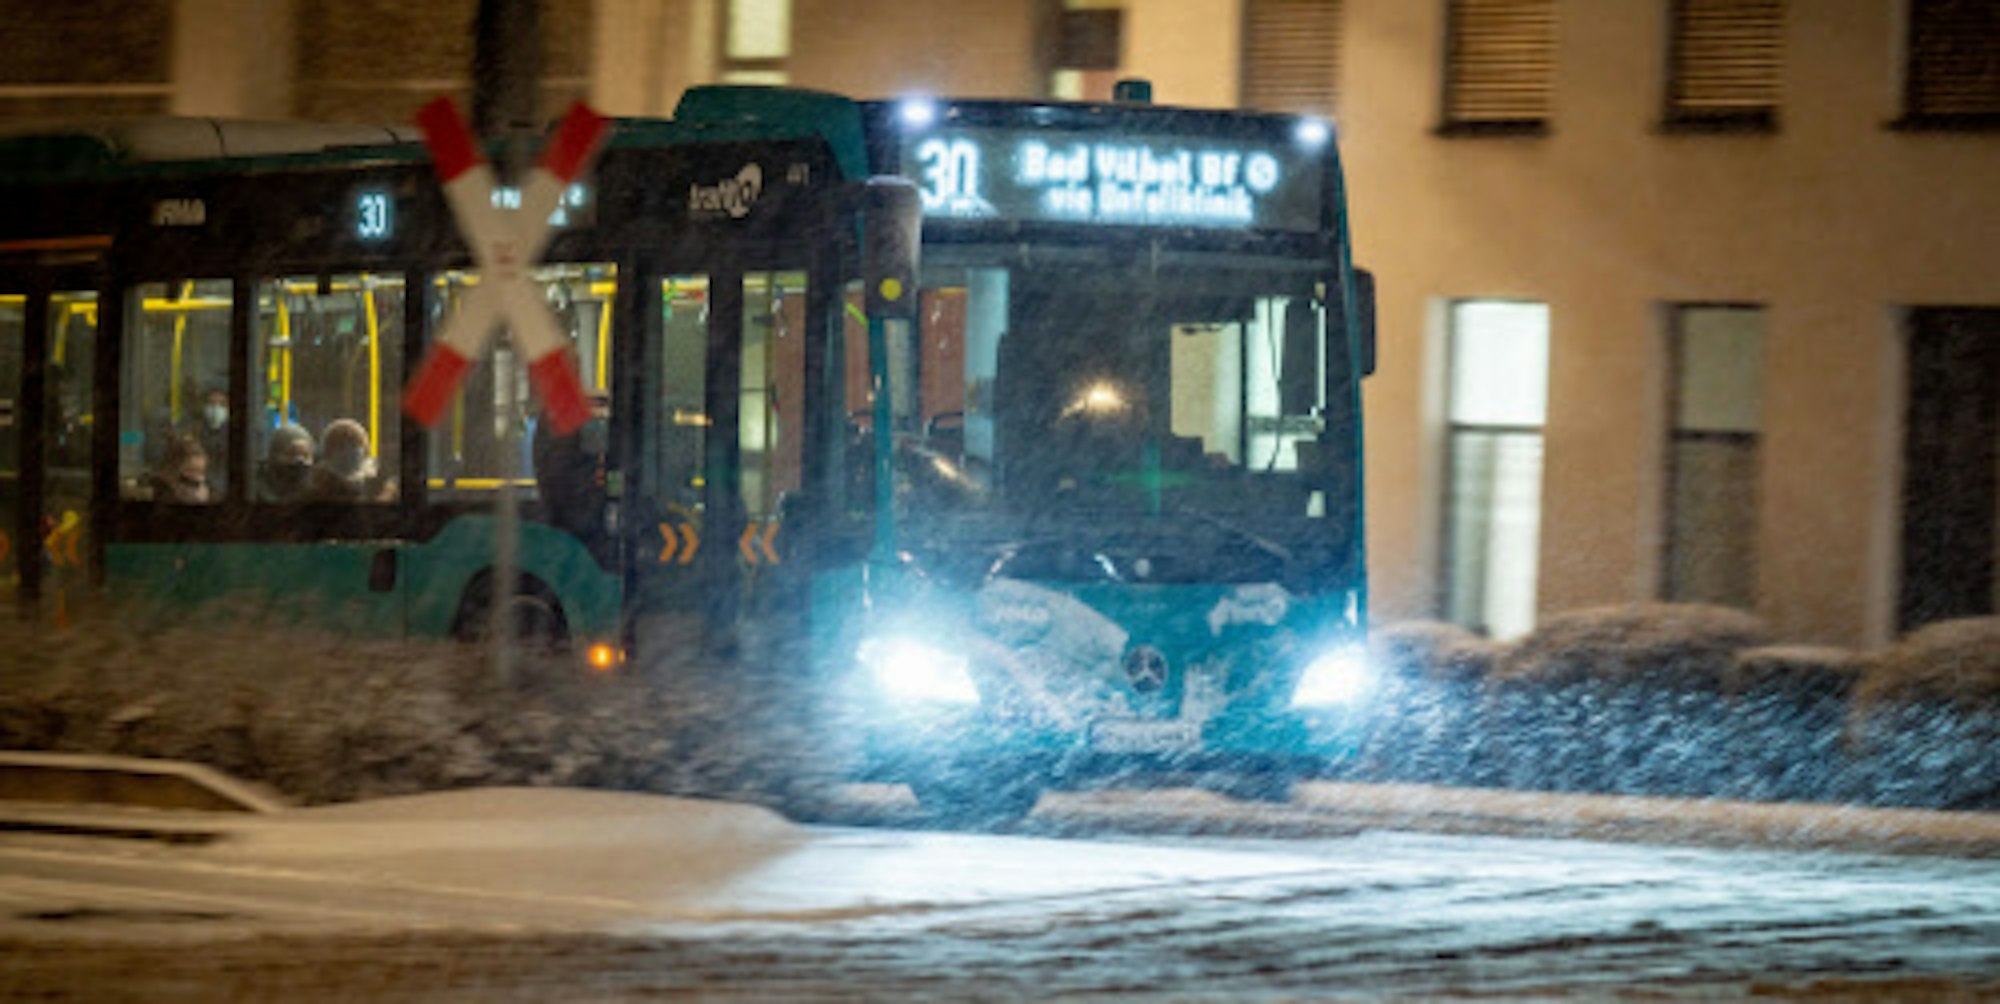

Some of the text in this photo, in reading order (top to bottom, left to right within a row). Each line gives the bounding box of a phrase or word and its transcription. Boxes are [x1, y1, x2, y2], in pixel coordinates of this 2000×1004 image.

[918, 140, 978, 208] 30
[1024, 142, 1241, 186] Bad Vilbel Bf
[358, 193, 387, 238] 30
[1048, 183, 1092, 213] via
